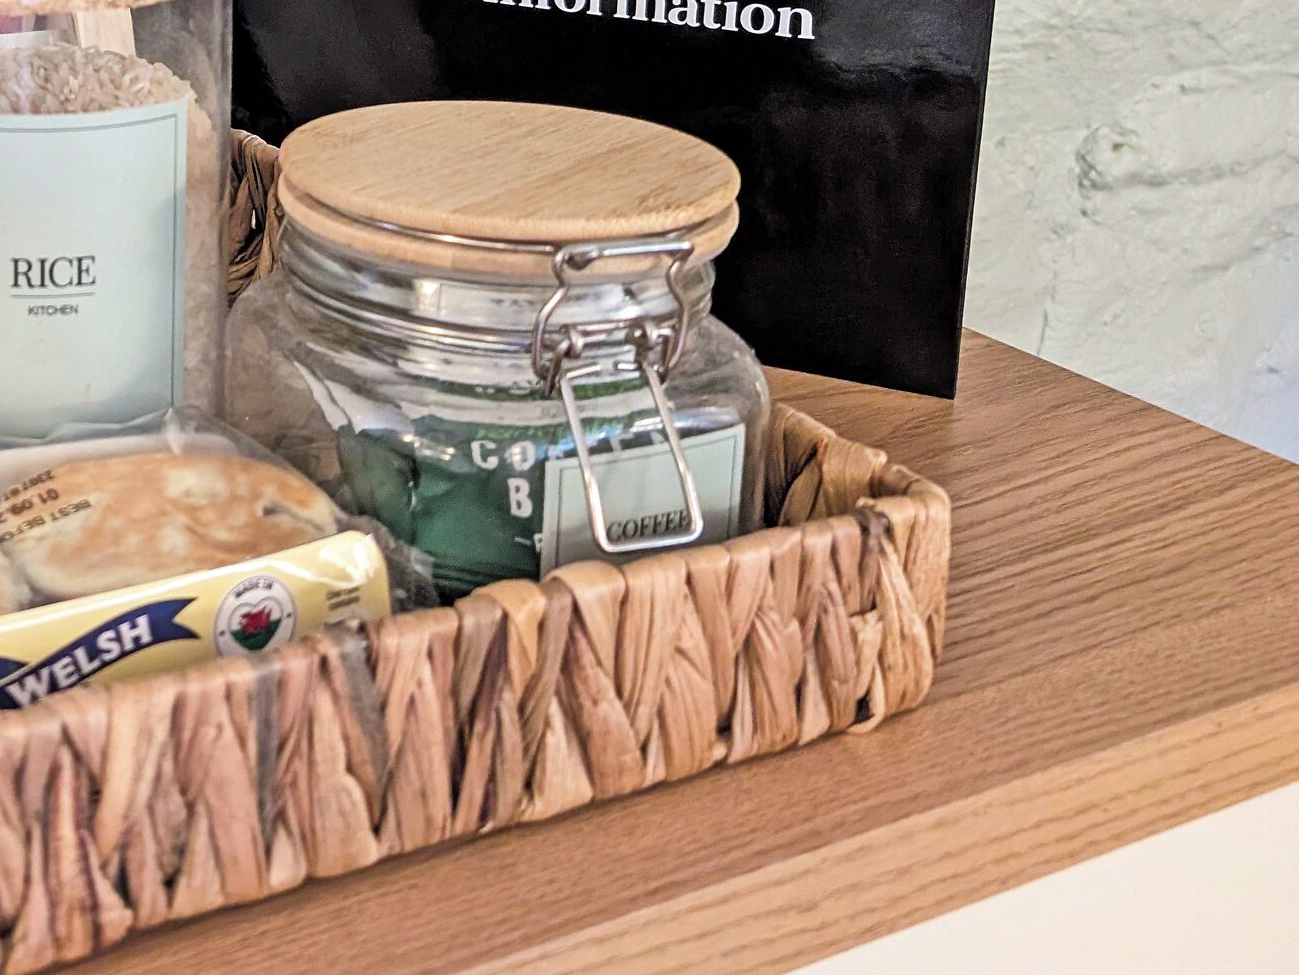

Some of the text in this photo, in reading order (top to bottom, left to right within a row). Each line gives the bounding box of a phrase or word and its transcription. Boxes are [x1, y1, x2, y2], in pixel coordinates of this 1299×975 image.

[10, 255, 97, 290] RICE
[27, 302, 79, 316] KITCHEN
[3, 613, 153, 710] WELSH
